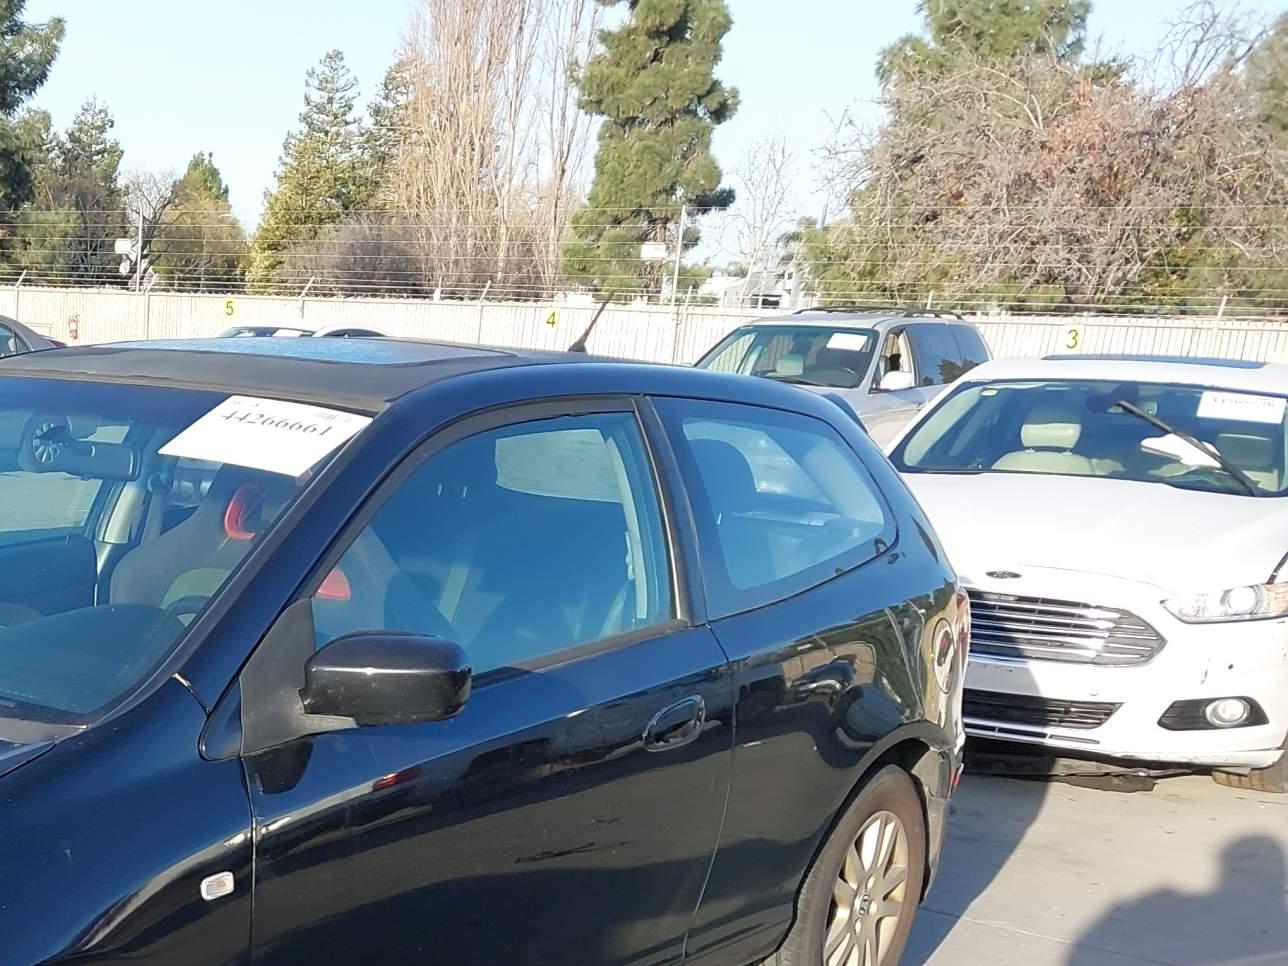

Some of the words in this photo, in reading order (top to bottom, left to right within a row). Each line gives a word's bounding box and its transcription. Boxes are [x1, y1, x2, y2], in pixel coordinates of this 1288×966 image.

[226, 300, 234, 316] 5
[546, 311, 556, 328] 4
[1066, 329, 1079, 349] 3
[221, 410, 333, 436] 44266661
